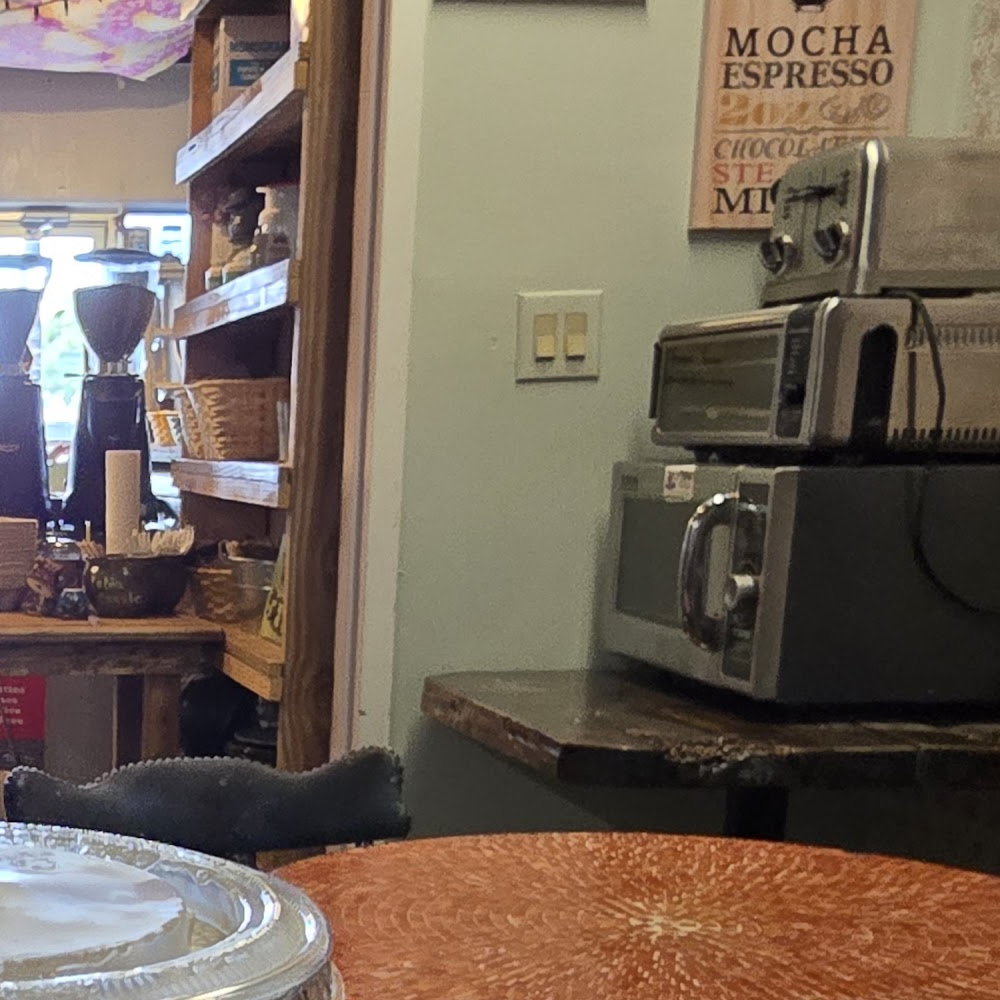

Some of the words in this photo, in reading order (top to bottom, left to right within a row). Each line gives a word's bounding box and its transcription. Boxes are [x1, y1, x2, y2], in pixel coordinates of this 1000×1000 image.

[724, 25, 893, 57] MOCHA
[721, 58, 894, 90] ESPRESSO
[712, 162, 775, 184] STE
